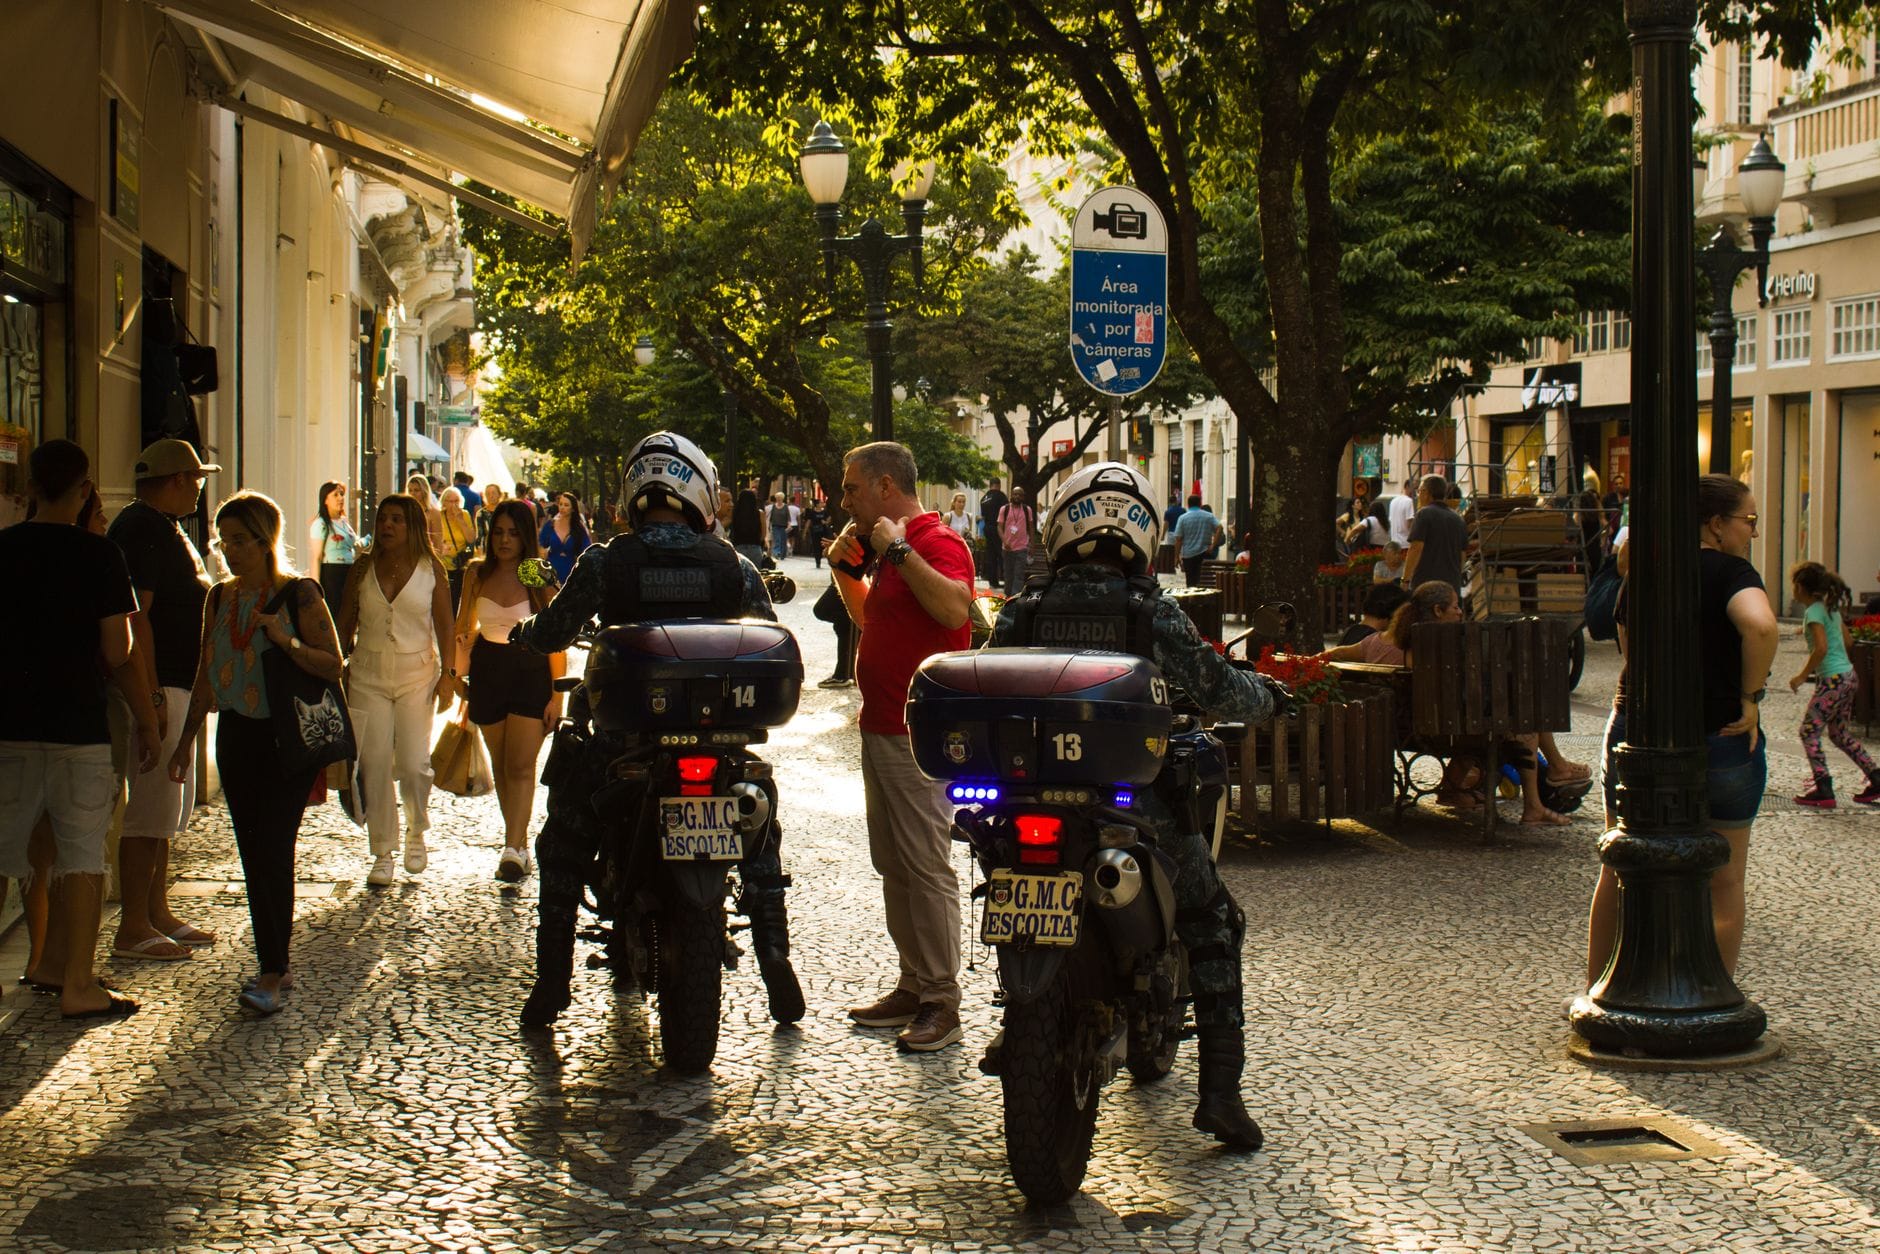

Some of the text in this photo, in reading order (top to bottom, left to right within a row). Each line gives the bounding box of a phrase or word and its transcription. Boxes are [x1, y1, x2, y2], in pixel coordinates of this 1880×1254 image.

[1101, 275, 1138, 293] Área
[1775, 271, 1816, 300] Hering
[1075, 300, 1163, 315] monitorada
[1105, 323, 1131, 338] por
[1085, 342, 1152, 357] câmeras
[667, 460, 694, 484] GM
[1068, 498, 1151, 532] GM GM
[641, 570, 708, 586] GUARDA
[642, 586, 708, 601] MUNICIPAL
[1041, 621, 1117, 641] GUARDA
[732, 684, 757, 709] 14
[1052, 732, 1083, 762] 13
[666, 833, 740, 857] ESCOLTA
[985, 911, 1075, 938] ESCOLTA
